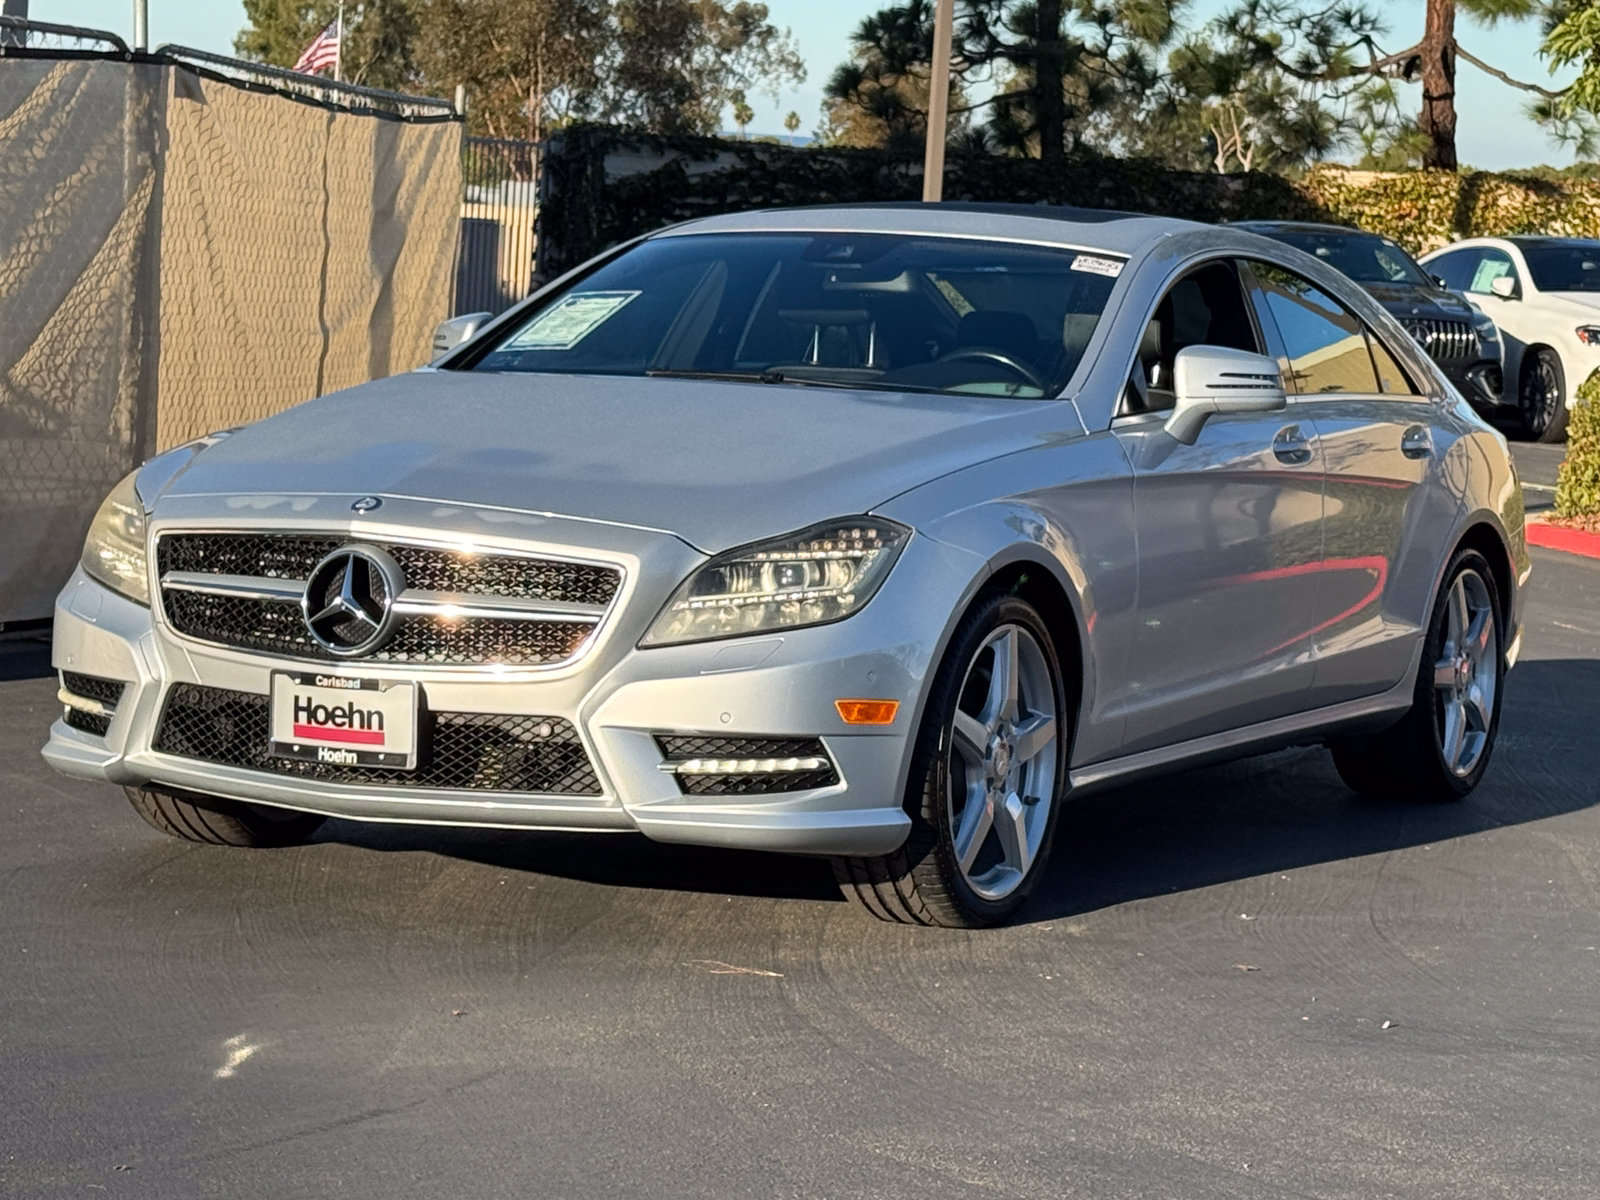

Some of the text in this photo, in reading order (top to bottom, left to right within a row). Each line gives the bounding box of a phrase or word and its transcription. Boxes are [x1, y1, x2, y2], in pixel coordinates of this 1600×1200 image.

[315, 674, 360, 689] Carlsbad
[293, 695, 385, 731] Hoehn
[318, 746, 358, 764] Hoehn
